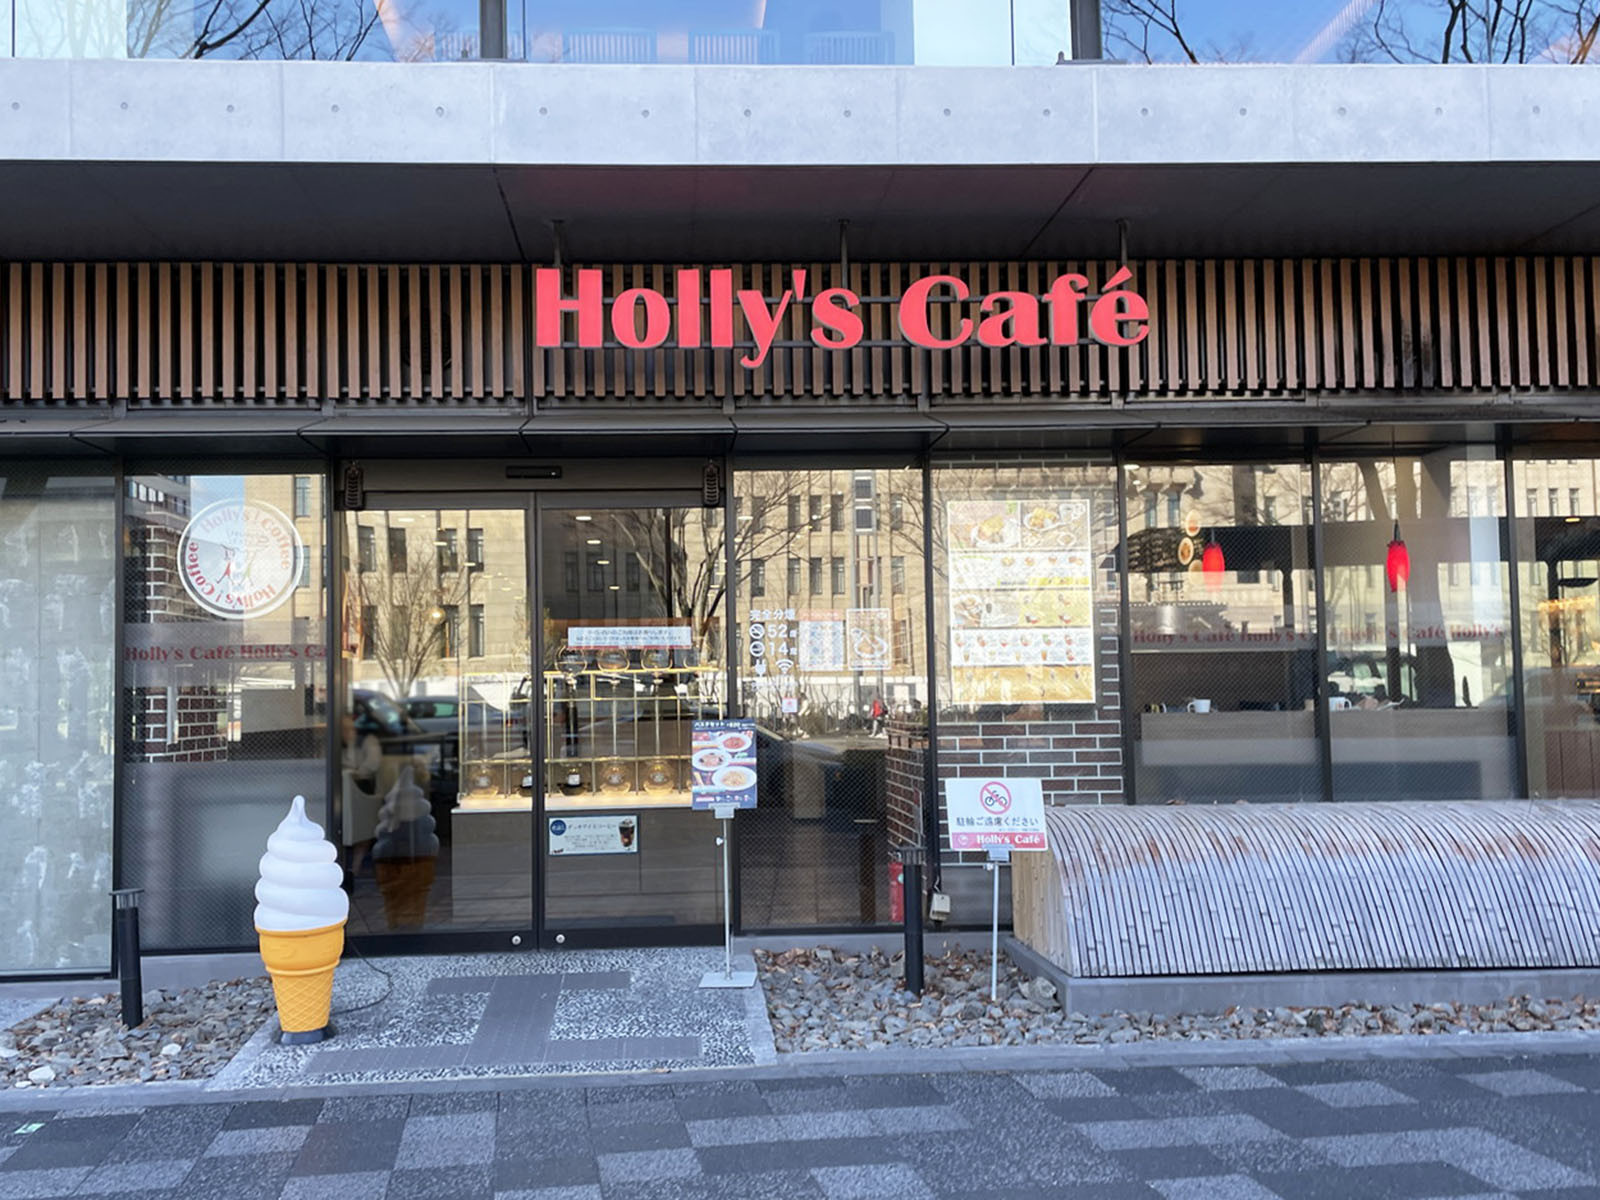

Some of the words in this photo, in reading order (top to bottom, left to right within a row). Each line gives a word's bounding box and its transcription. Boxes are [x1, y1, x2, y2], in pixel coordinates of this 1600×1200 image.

[535, 268, 864, 368] Holly's
[899, 266, 1151, 349] Café
[125, 647, 184, 662] Holly's
[190, 645, 235, 660] Café
[976, 834, 1010, 845] Holly's
[1014, 834, 1041, 844] Café
